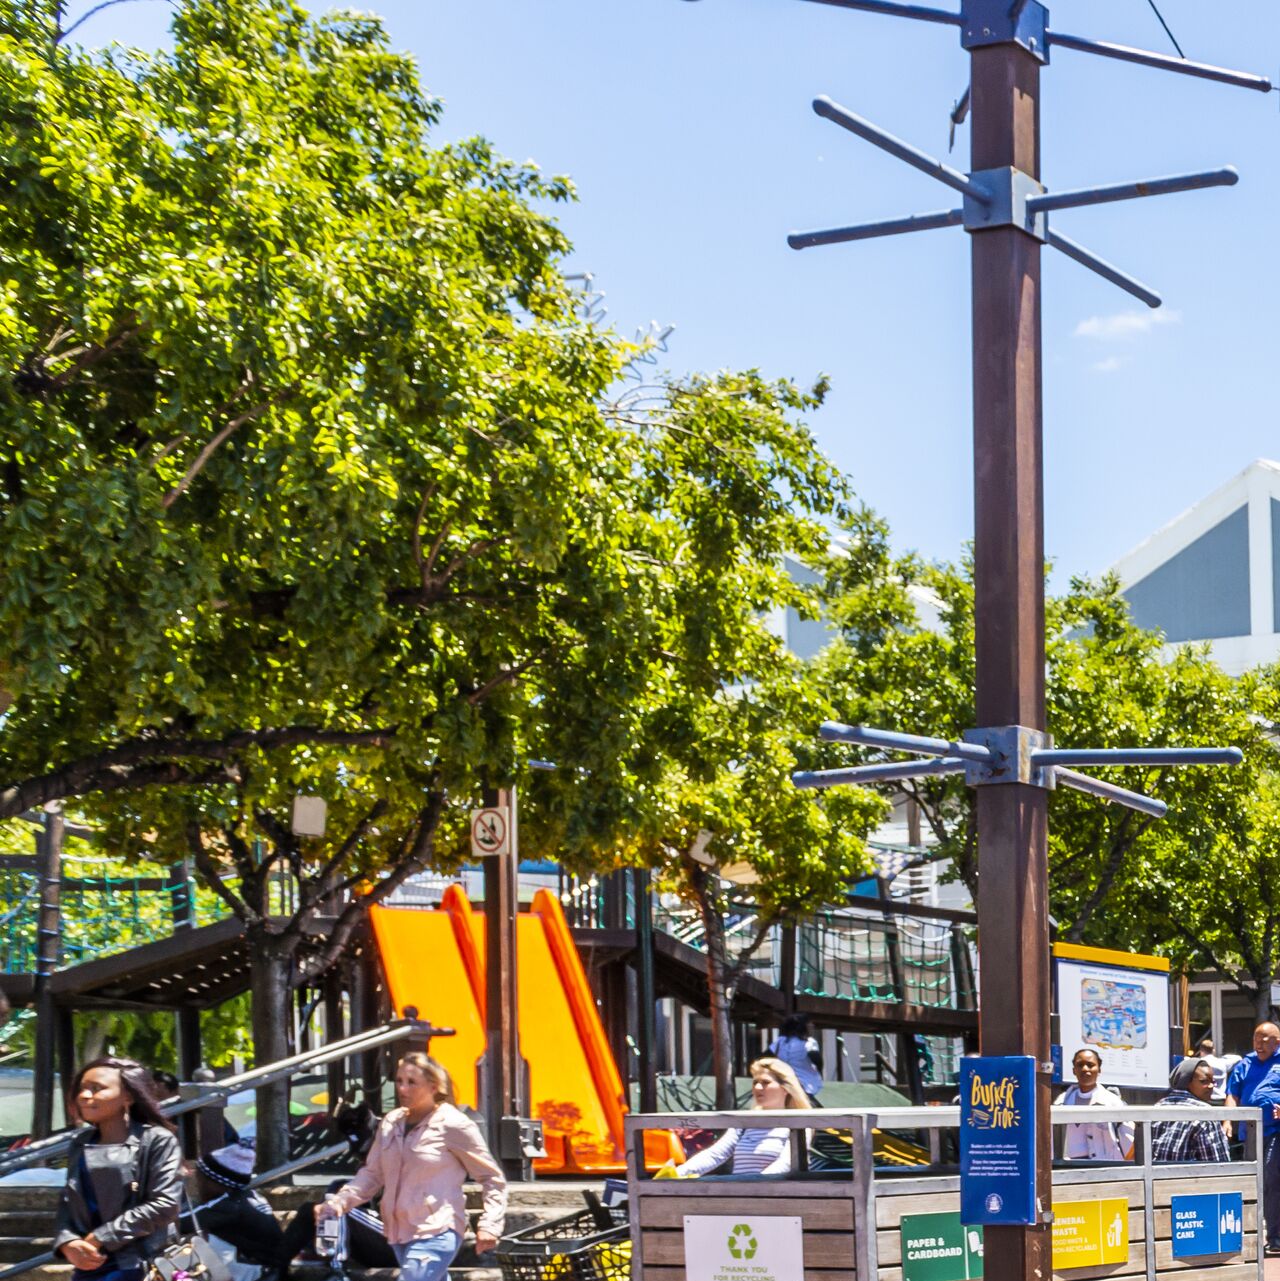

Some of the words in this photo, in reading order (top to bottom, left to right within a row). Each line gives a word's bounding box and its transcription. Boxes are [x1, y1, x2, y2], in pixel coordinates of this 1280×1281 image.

[971, 1075, 1015, 1112] BUSKER
[991, 1106, 1014, 1128] STOP
[1175, 1211, 1197, 1220] GLASS
[1176, 1220, 1204, 1229] PLASTIC
[1176, 1230, 1195, 1239] CANS
[907, 1238, 936, 1248] PAPER
[938, 1237, 945, 1246] &
[907, 1247, 963, 1260] CARDBOARD
